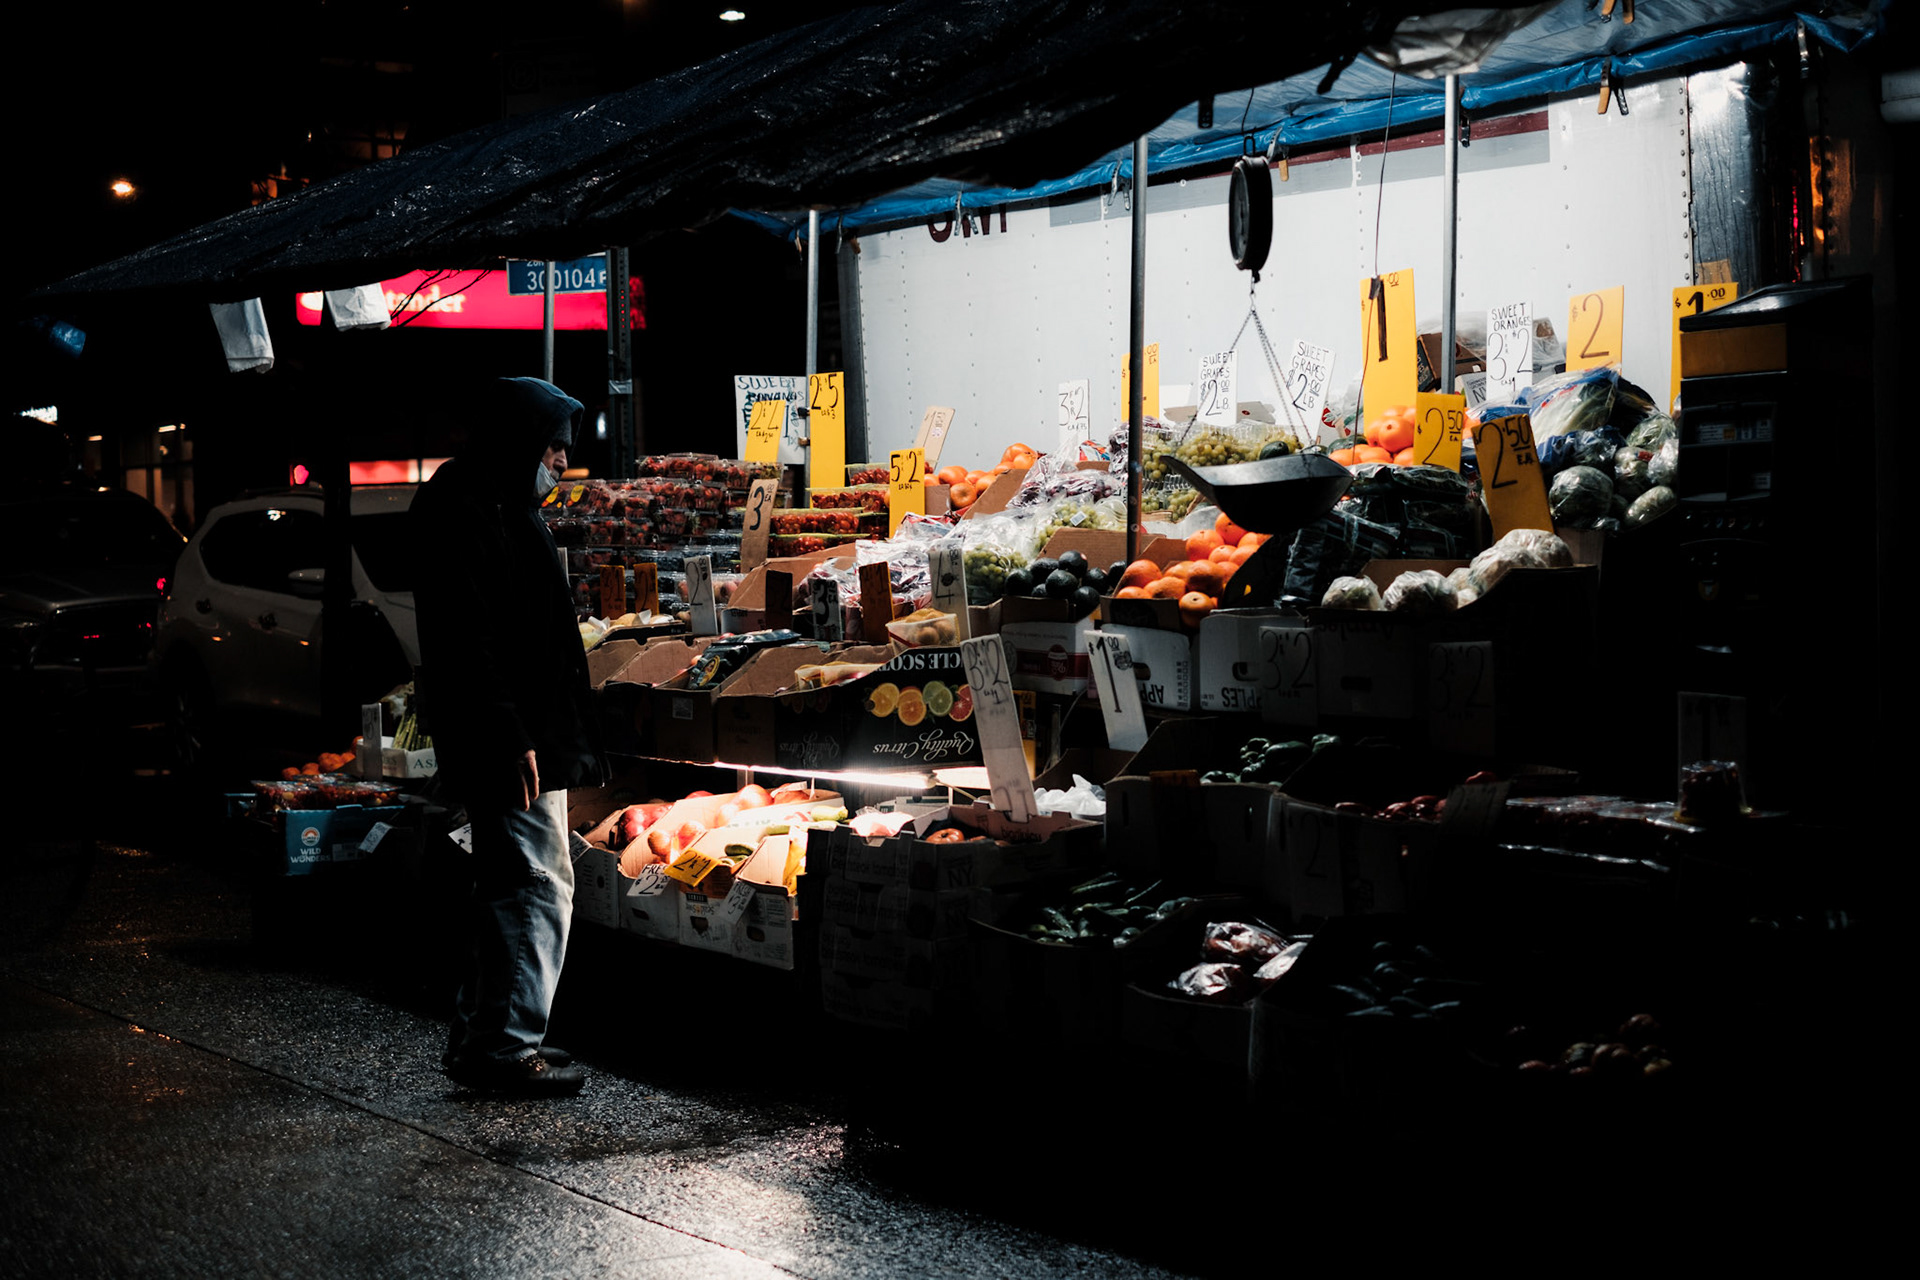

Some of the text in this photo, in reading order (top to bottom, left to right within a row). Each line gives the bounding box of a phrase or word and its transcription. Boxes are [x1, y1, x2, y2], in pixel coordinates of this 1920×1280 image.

[1491, 302, 1526, 321] SWEET
[1493, 315, 1532, 332] ORANGES
[1203, 351, 1235, 367] SWEET
[1200, 366, 1231, 381] GRAPES
[928, 652, 964, 671] CLE
[871, 728, 975, 762] Quality Citrus
[290, 854, 331, 864] WONDERS
[300, 847, 322, 856] WILD
